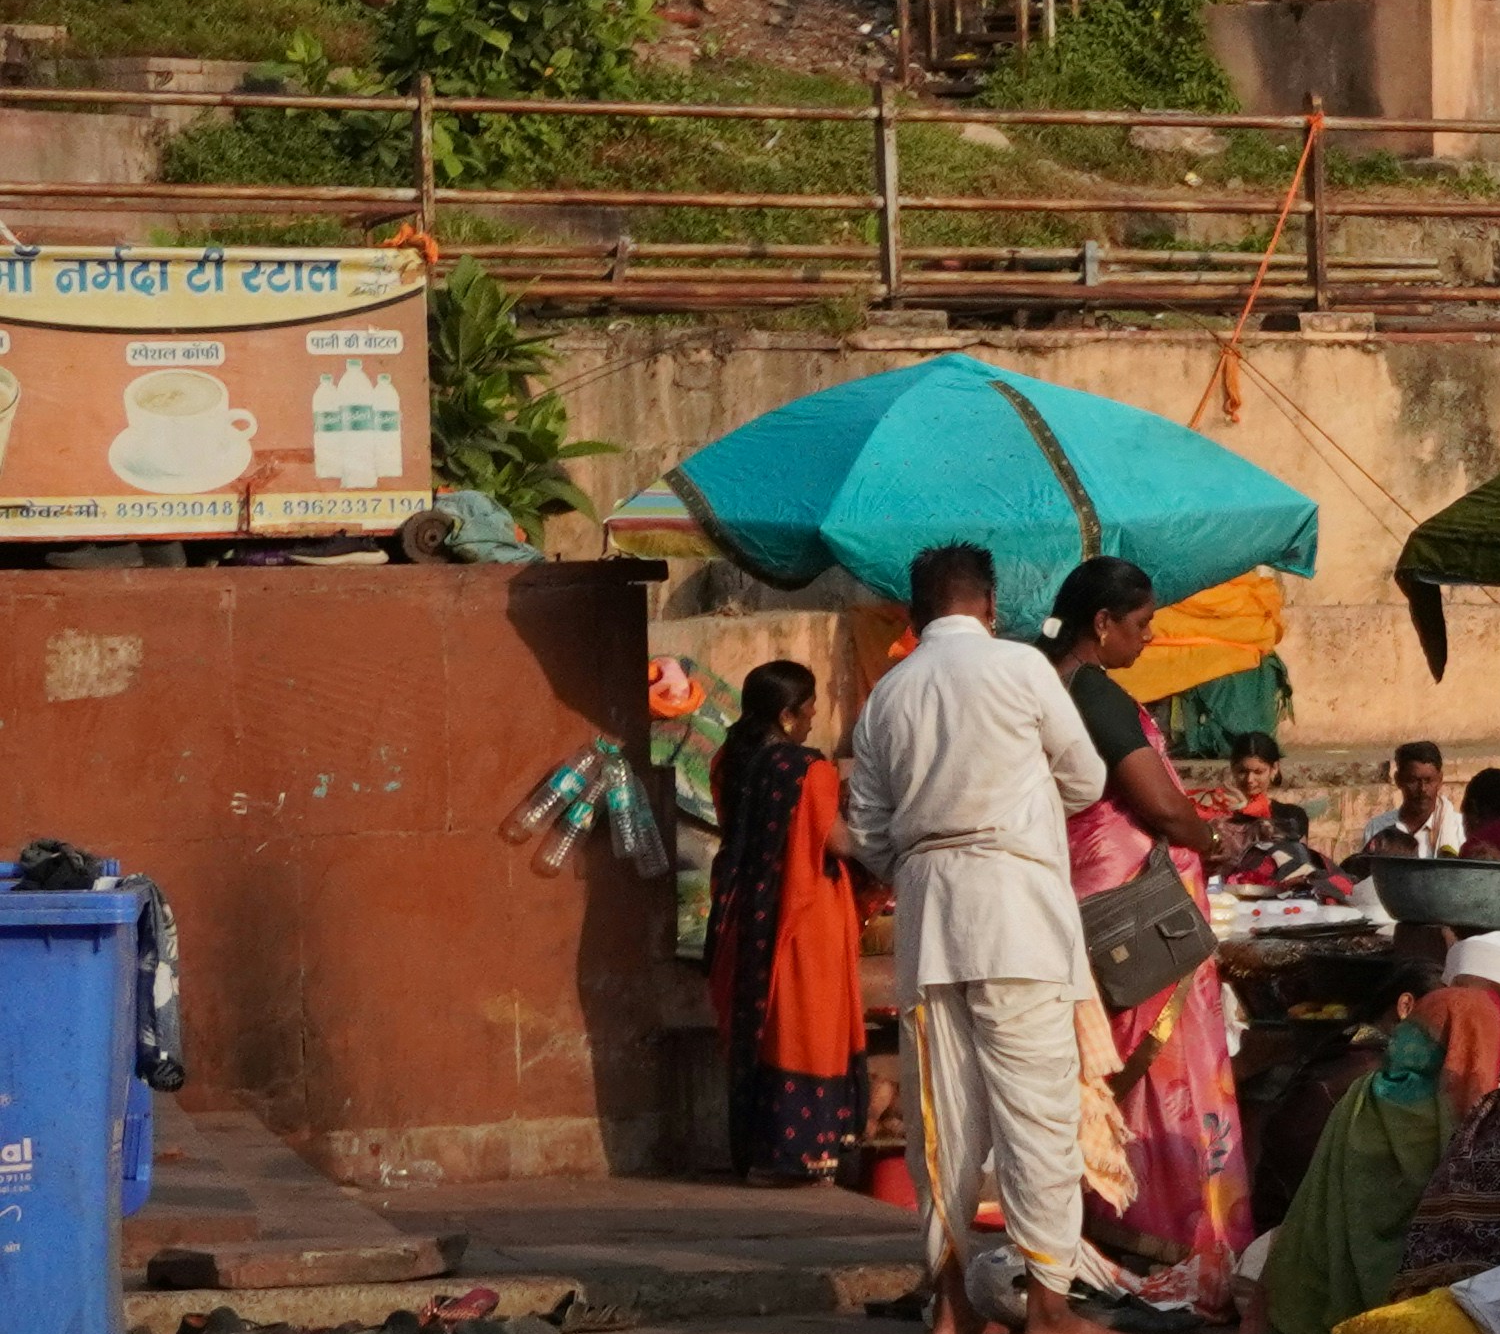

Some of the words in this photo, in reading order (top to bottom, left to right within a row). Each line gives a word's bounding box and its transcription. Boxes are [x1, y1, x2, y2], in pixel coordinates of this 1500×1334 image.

[53, 246, 172, 296] नर्मदा
[184, 247, 224, 293] टी
[238, 259, 341, 294] स्टाल
[131, 343, 177, 362] स्पेशल
[182, 342, 220, 361] कॉफी
[310, 333, 340, 350] पानी
[344, 333, 360, 349] की
[116, 499, 272, 519] 895930484,
[283, 497, 426, 516] 8962337194
